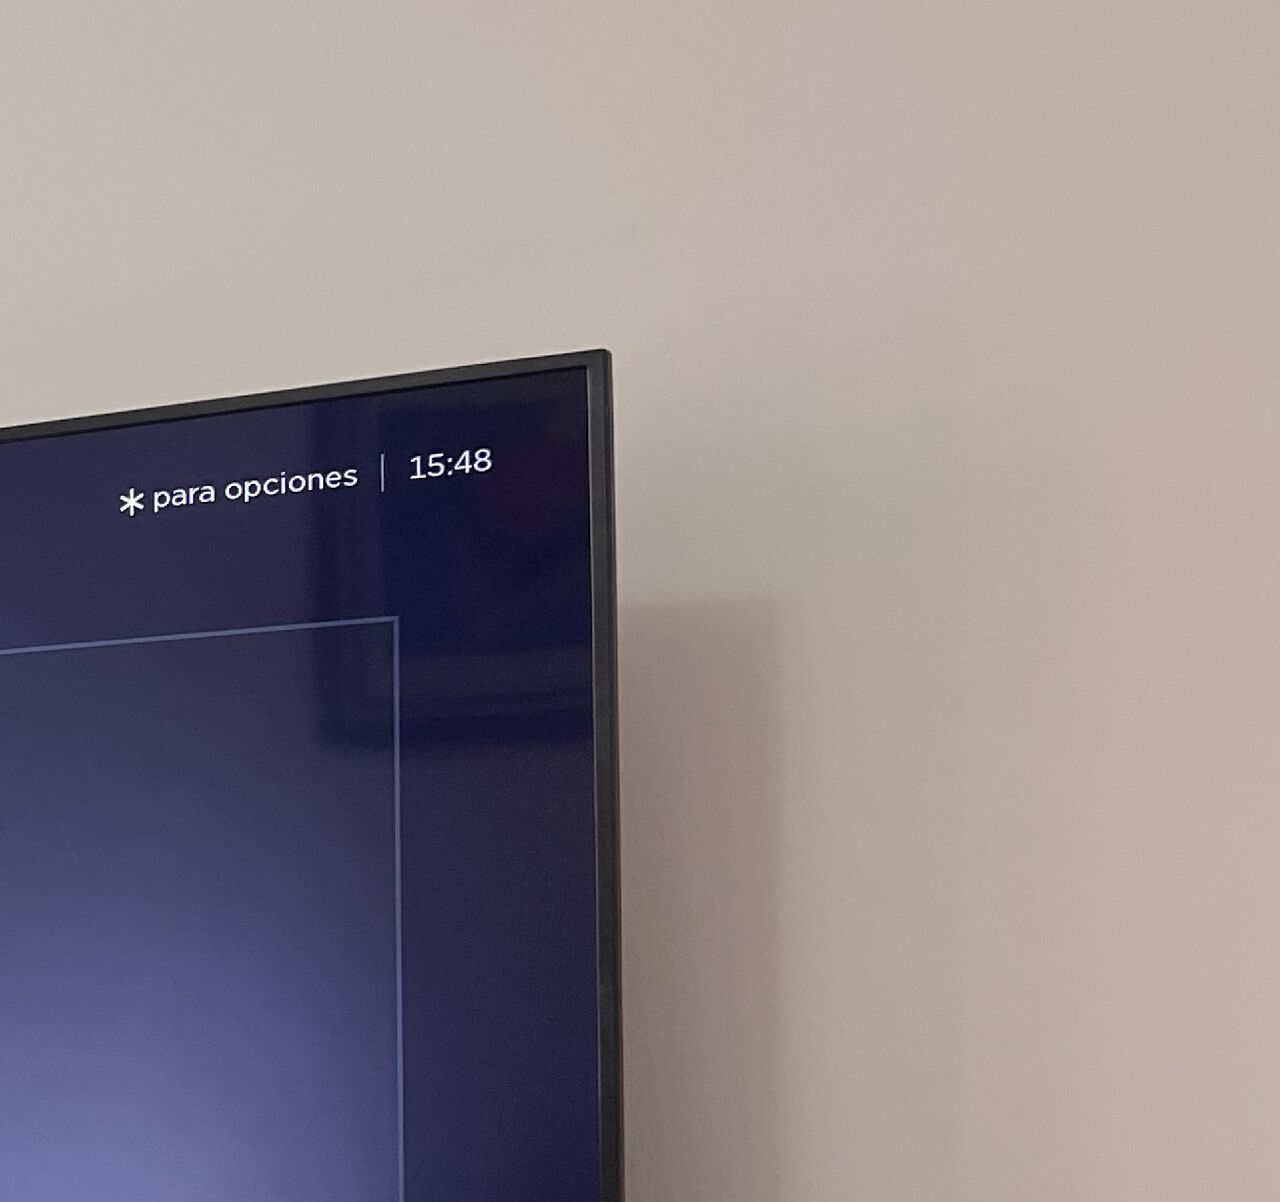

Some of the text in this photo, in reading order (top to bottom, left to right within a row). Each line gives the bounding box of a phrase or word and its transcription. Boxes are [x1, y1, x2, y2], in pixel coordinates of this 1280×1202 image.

[408, 448, 493, 480] 15:48
[152, 465, 359, 512] para opciones
